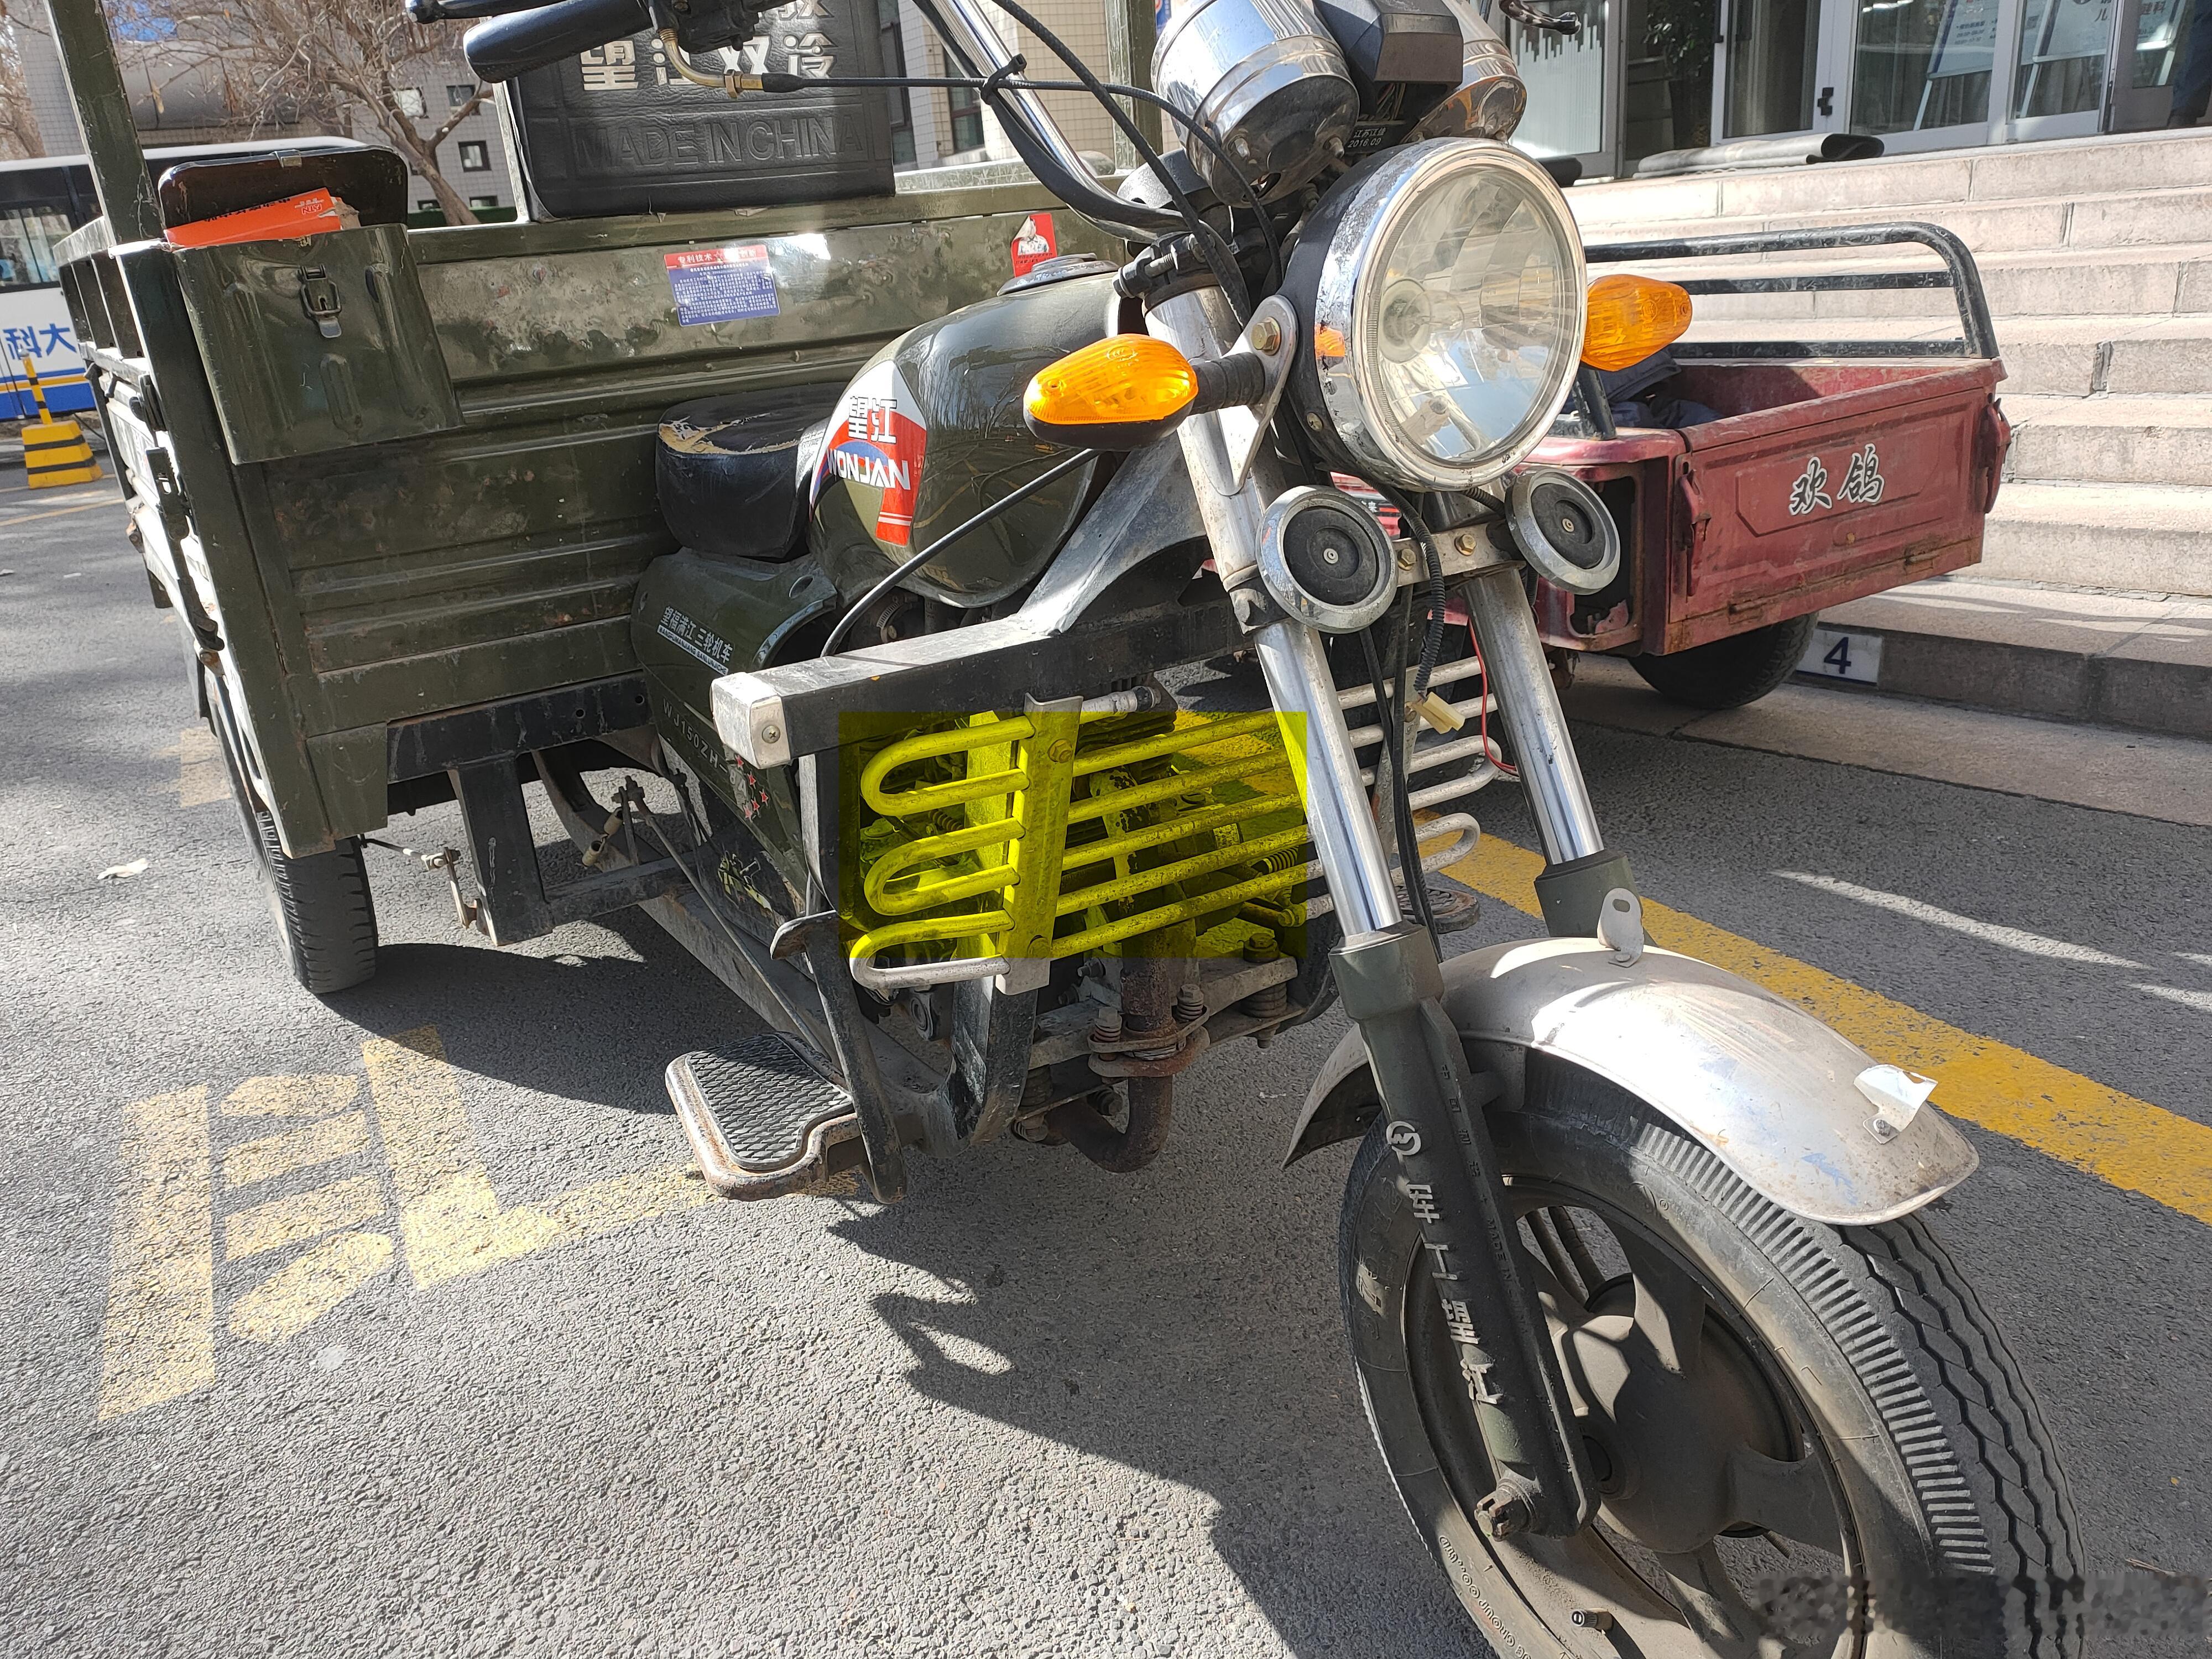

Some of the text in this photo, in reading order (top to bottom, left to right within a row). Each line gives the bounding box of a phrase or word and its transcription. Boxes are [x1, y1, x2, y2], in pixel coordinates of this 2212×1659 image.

[575, 115, 864, 167] MADE IN CHINA
[3, 322, 77, 360] 科大
[848, 395, 898, 445] 望江
[826, 447, 911, 491] WONJAN
[1788, 442, 1885, 516] 欢鸽
[1824, 637, 1852, 674] 4
